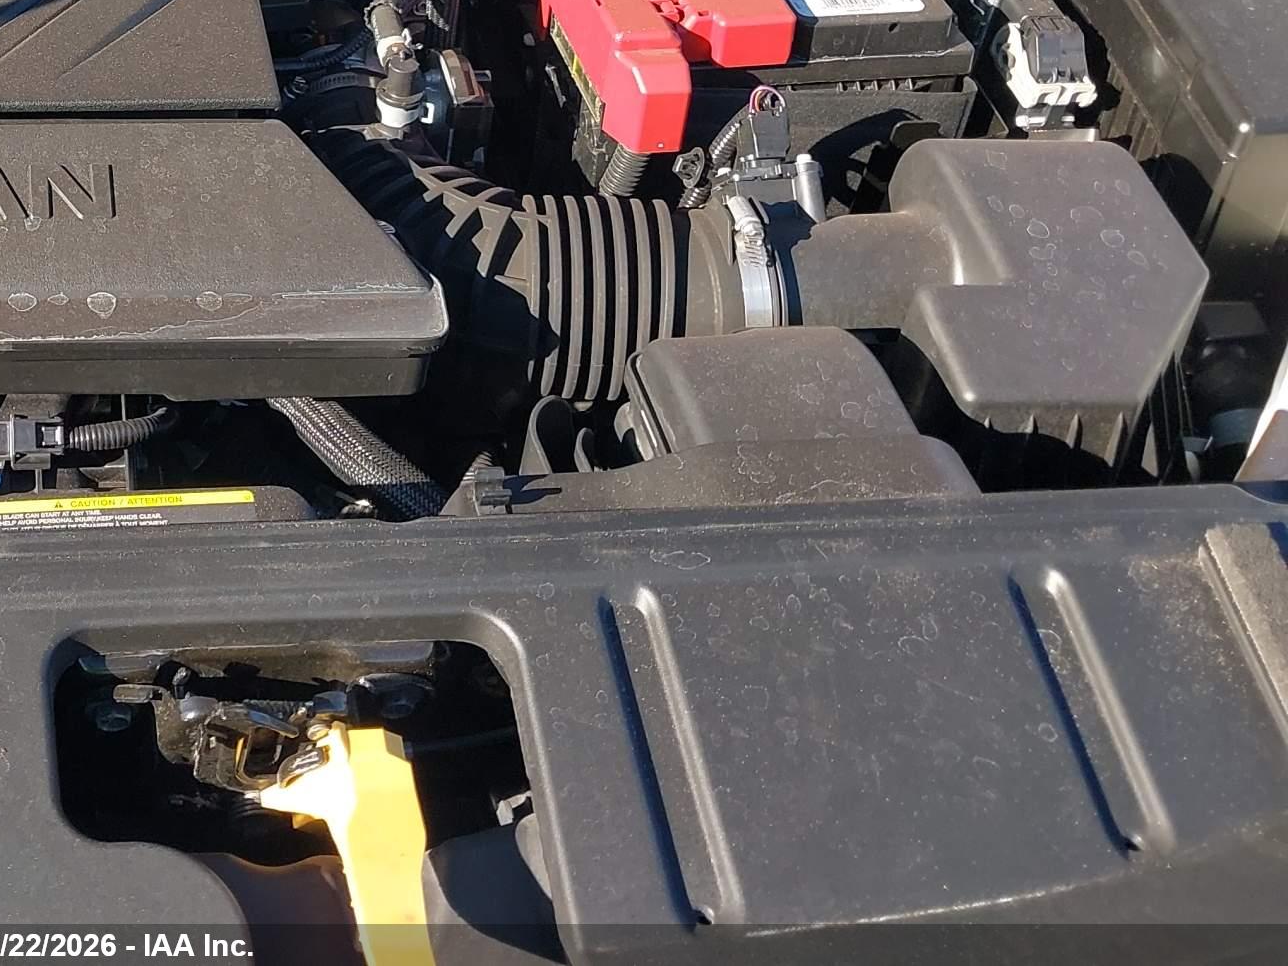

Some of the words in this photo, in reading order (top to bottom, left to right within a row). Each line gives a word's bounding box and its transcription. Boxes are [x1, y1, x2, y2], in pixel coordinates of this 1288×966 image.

[70, 499, 116, 508] CAUTION
[127, 496, 183, 506] ATTENTION
[114, 513, 138, 521] HANDS
